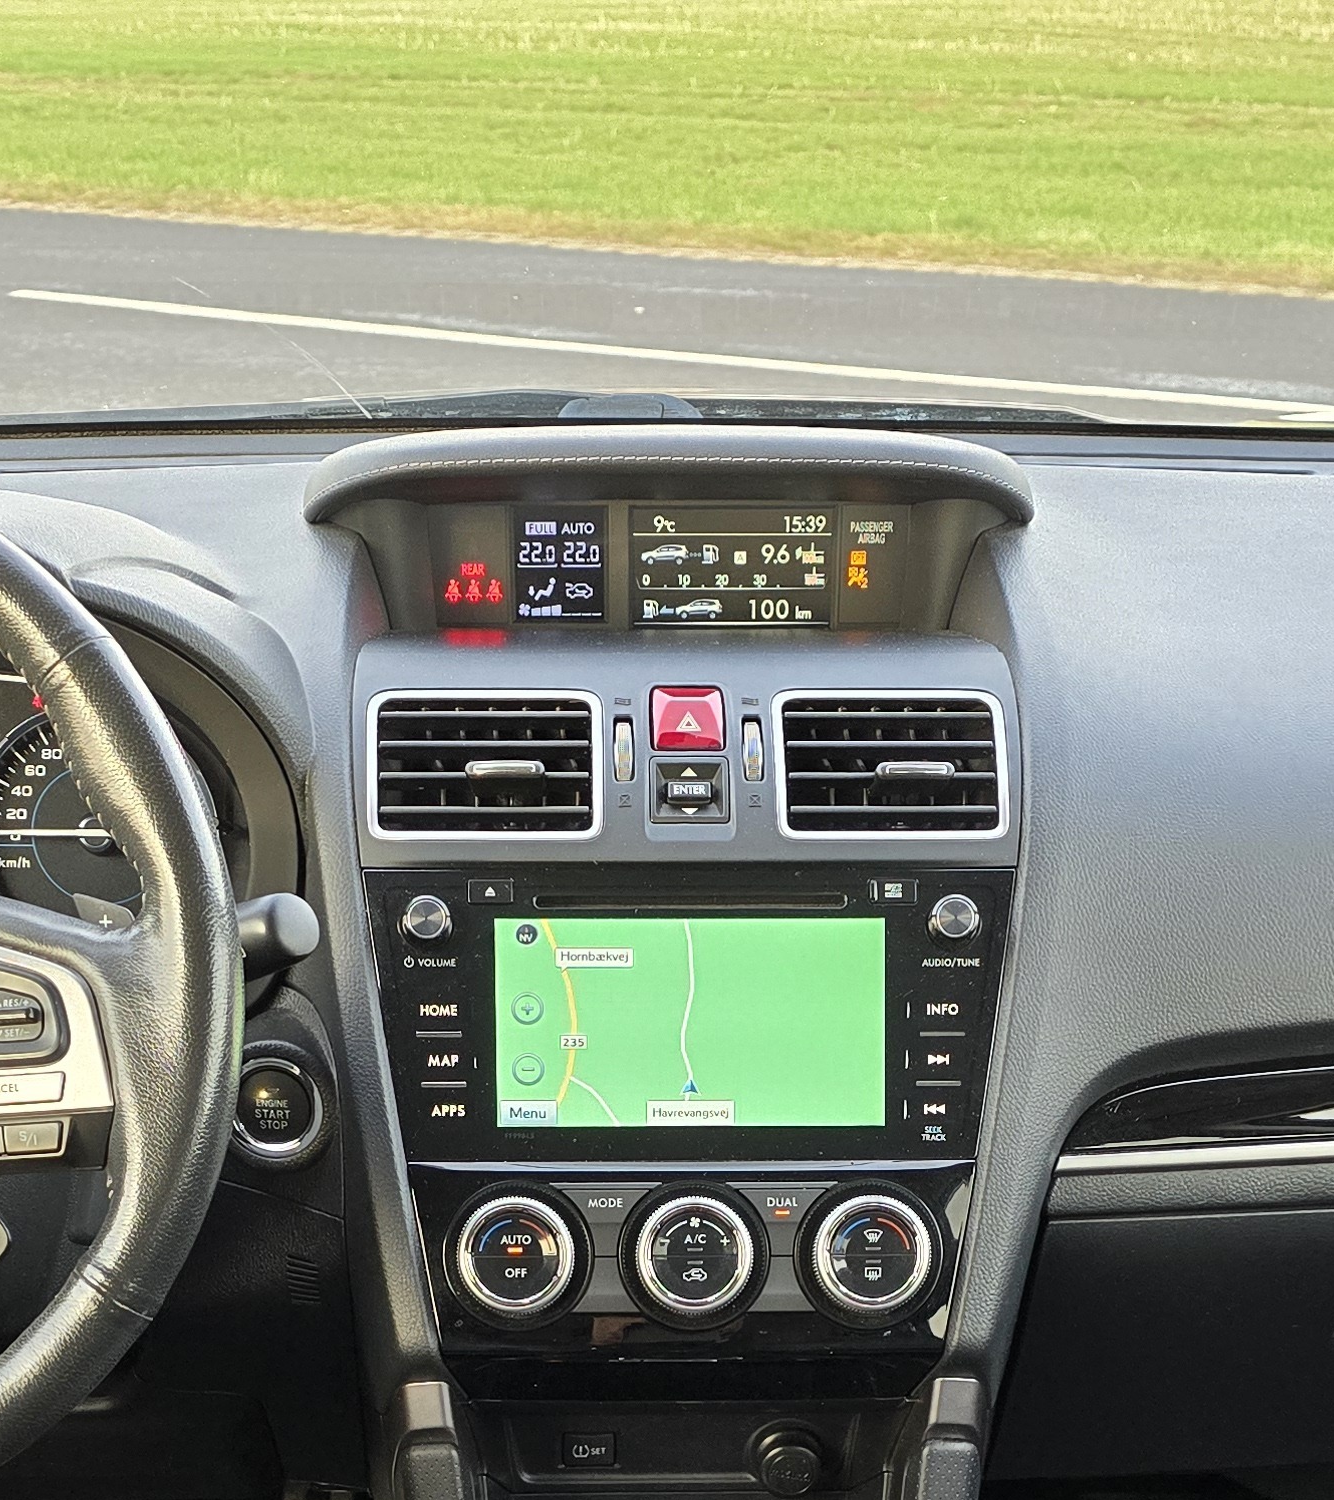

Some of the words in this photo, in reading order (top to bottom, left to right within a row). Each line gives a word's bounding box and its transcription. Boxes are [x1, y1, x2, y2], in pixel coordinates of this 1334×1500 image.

[528, 522, 555, 534] FULL
[561, 522, 595, 535] AUTO
[783, 515, 827, 533] 15:39
[850, 521, 894, 533] PASSENGER
[857, 533, 886, 544] AIRBAG
[519, 542, 556, 563] 22.0
[563, 542, 600, 563] 22.0
[761, 543, 790, 565] 9.6
[461, 563, 486, 576] REAR
[642, 574, 651, 586] 0
[677, 574, 691, 586] 10
[715, 574, 729, 586] 20
[753, 574, 767, 586] 30
[748, 599, 790, 620] 100
[795, 605, 812, 620] km
[41, 749, 63, 760] 80
[24, 765, 46, 776] 60
[11, 785, 33, 797] 40
[673, 784, 706, 795] ENTER
[5, 808, 27, 820] 20
[418, 958, 457, 968] VOLUME
[560, 950, 629, 964] Hornbækvej
[921, 957, 981, 968] AUDIO/TUNE
[419, 1004, 458, 1017] HOME
[926, 1003, 959, 1016] INFO
[563, 1038, 585, 1047] 235
[427, 1055, 459, 1068] MAP
[255, 1099, 288, 1108] ENGINE
[254, 1109, 291, 1119] START
[431, 1104, 466, 1118] APPS
[509, 1107, 547, 1119] Menu
[652, 1107, 729, 1119] Havrevangsvej
[259, 1119, 288, 1130] STOP
[921, 1133, 947, 1142] TRACK
[588, 1197, 623, 1208] MODE
[767, 1197, 798, 1207] DUAL
[500, 1234, 532, 1246] AUTO
[683, 1233, 707, 1246] A/C
[504, 1268, 528, 1279] OFF
[590, 1446, 606, 1455] SET
